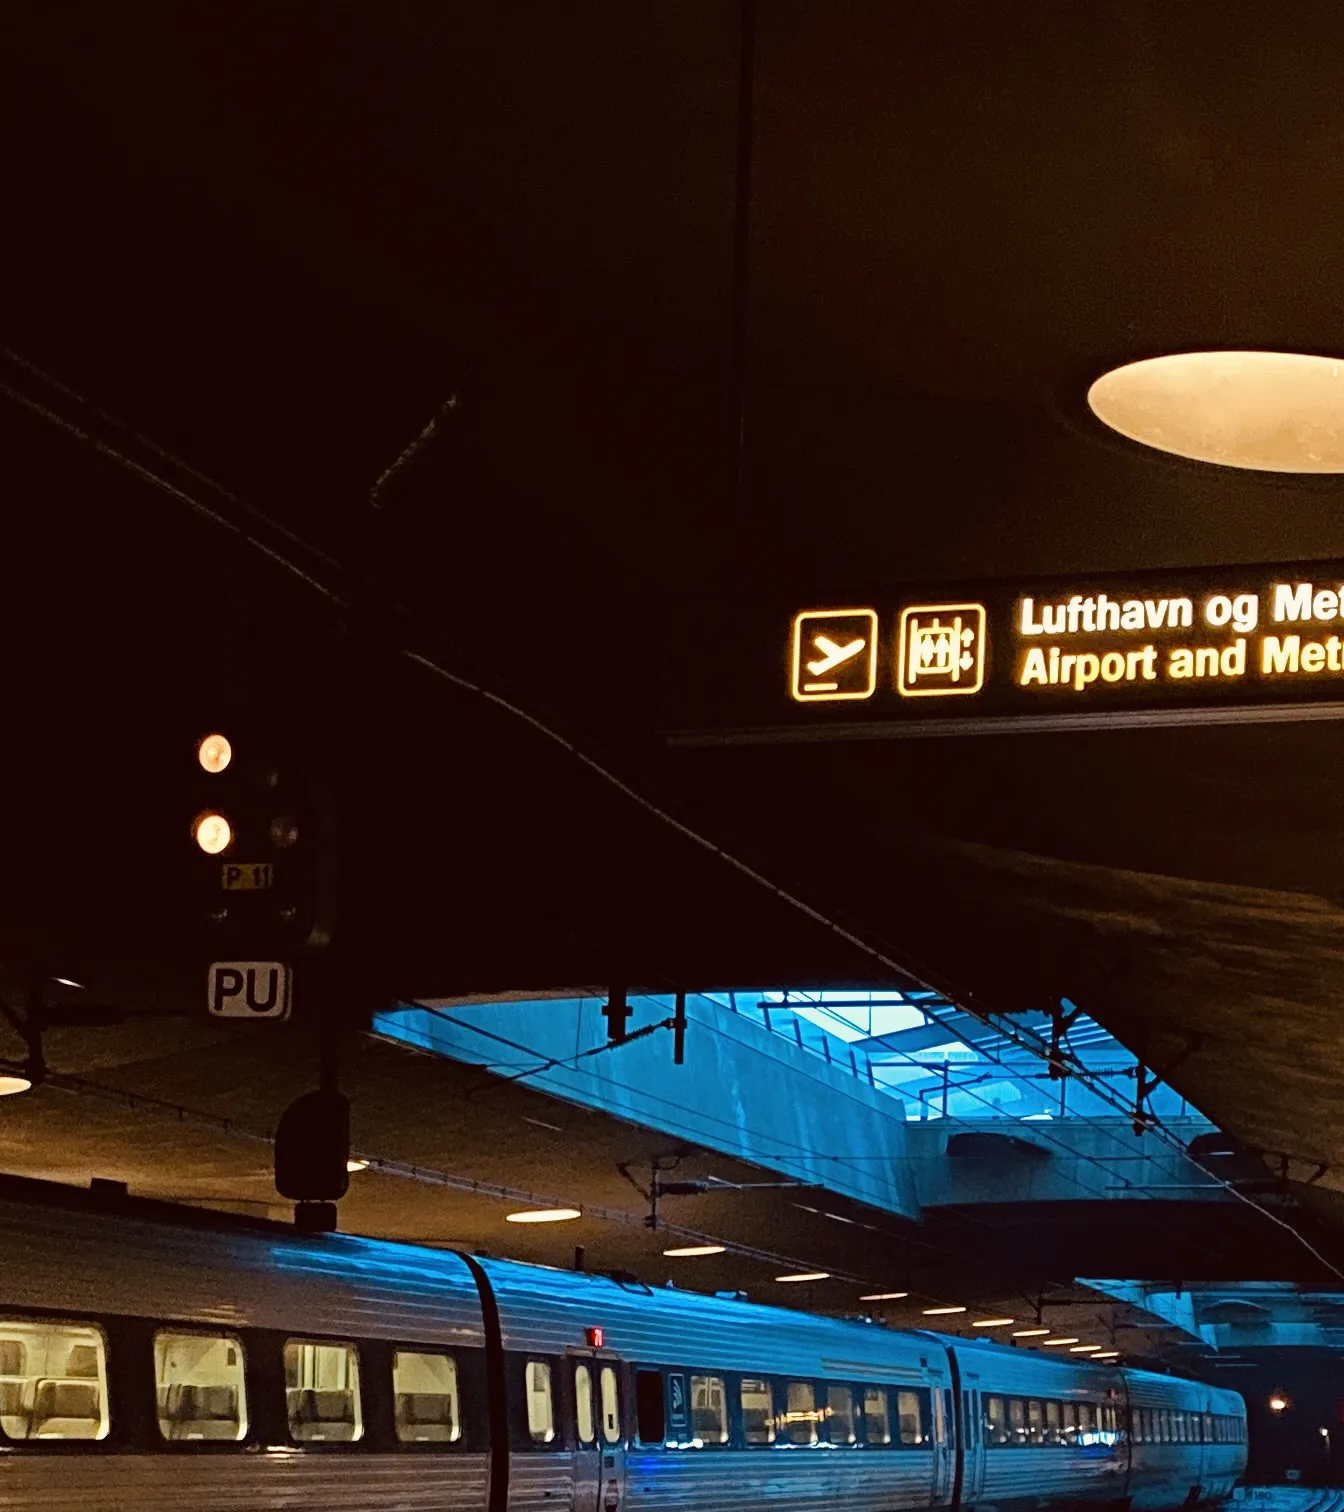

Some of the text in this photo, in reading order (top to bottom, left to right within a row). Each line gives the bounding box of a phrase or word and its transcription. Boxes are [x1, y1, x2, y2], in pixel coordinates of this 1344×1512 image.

[1020, 594, 1193, 635] Lufthavn
[1205, 593, 1258, 632] og
[1020, 645, 1157, 691] Airport
[1169, 638, 1246, 678] and
[214, 968, 278, 1012] PU
